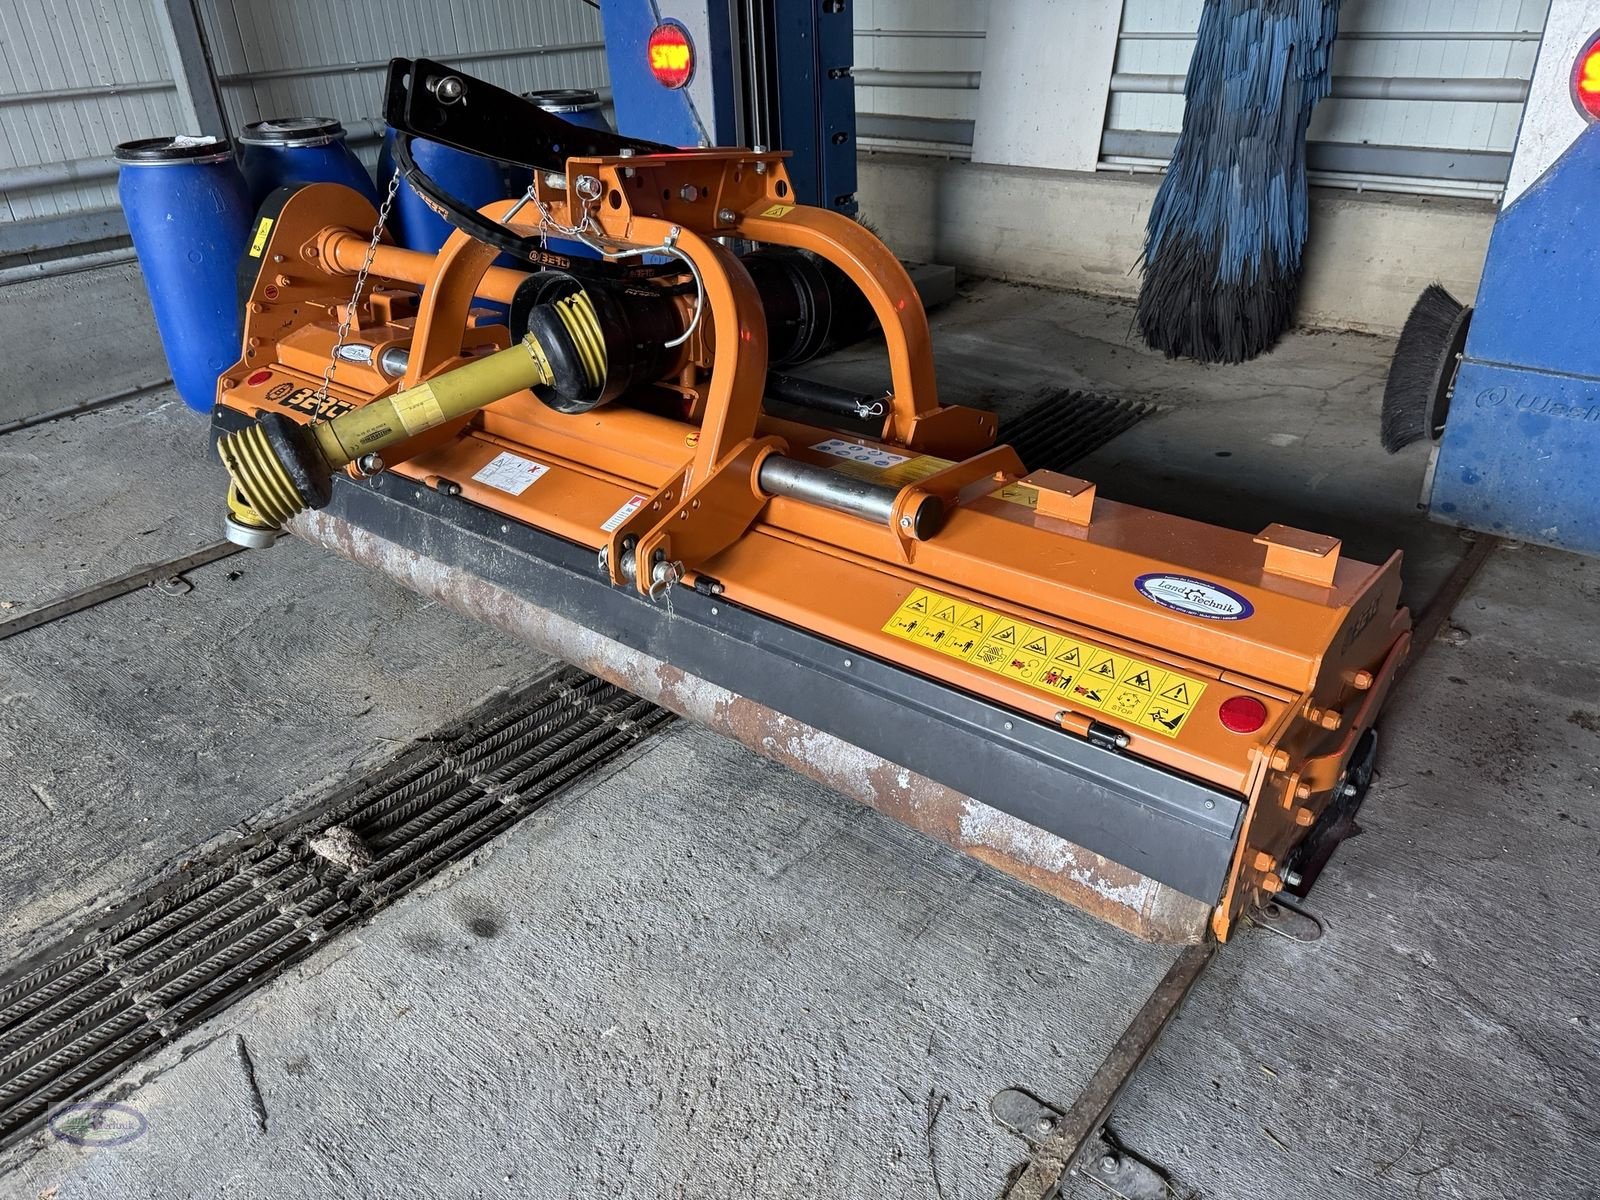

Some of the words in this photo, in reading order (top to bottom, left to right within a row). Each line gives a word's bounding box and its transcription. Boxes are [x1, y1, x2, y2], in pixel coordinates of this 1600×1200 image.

[1158, 580, 1188, 594] Land
[1192, 594, 1234, 613] Technik
[1111, 704, 1133, 715] STOP
